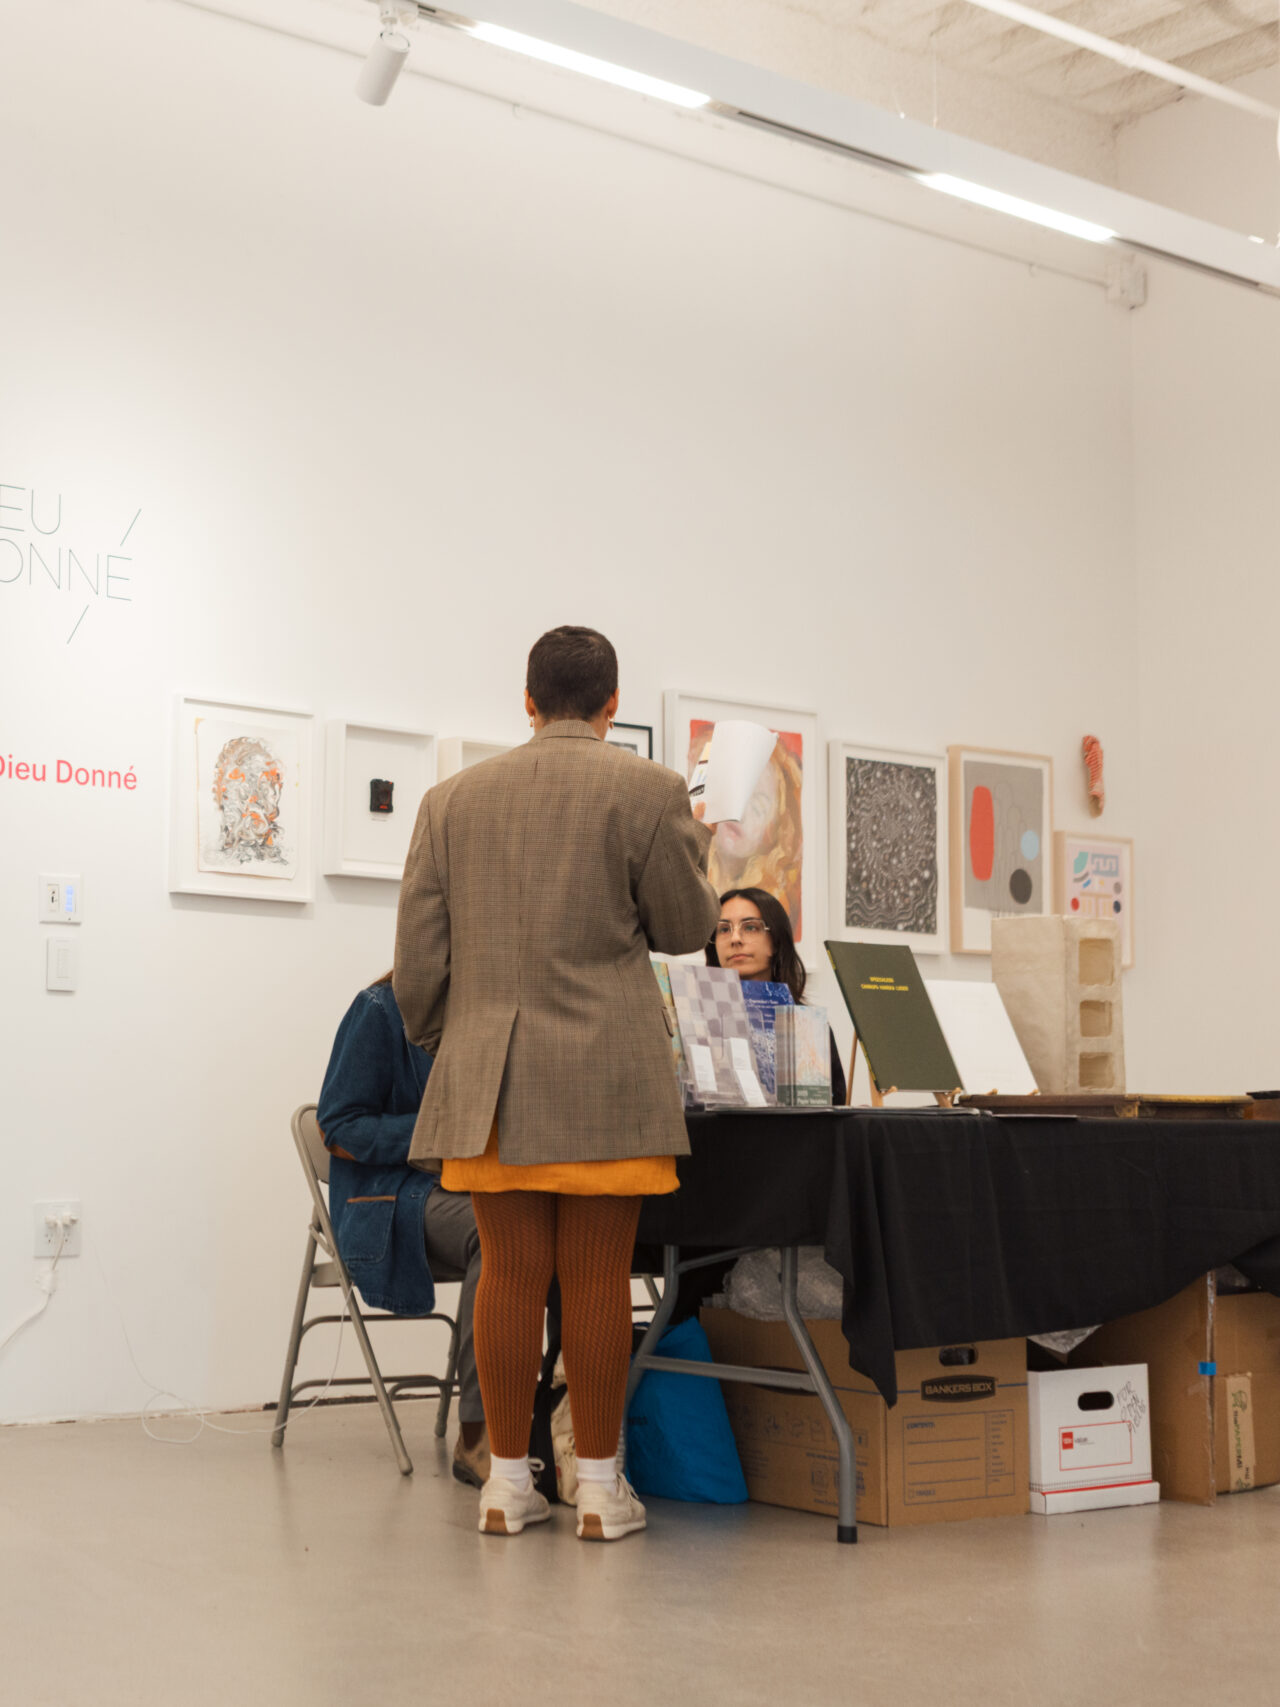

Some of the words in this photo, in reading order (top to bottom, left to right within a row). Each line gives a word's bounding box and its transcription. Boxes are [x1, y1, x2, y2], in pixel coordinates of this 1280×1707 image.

[56, 760, 138, 790] Donné
[925, 1383, 971, 1395] BANKERS
[972, 1382, 992, 1392] BOX
